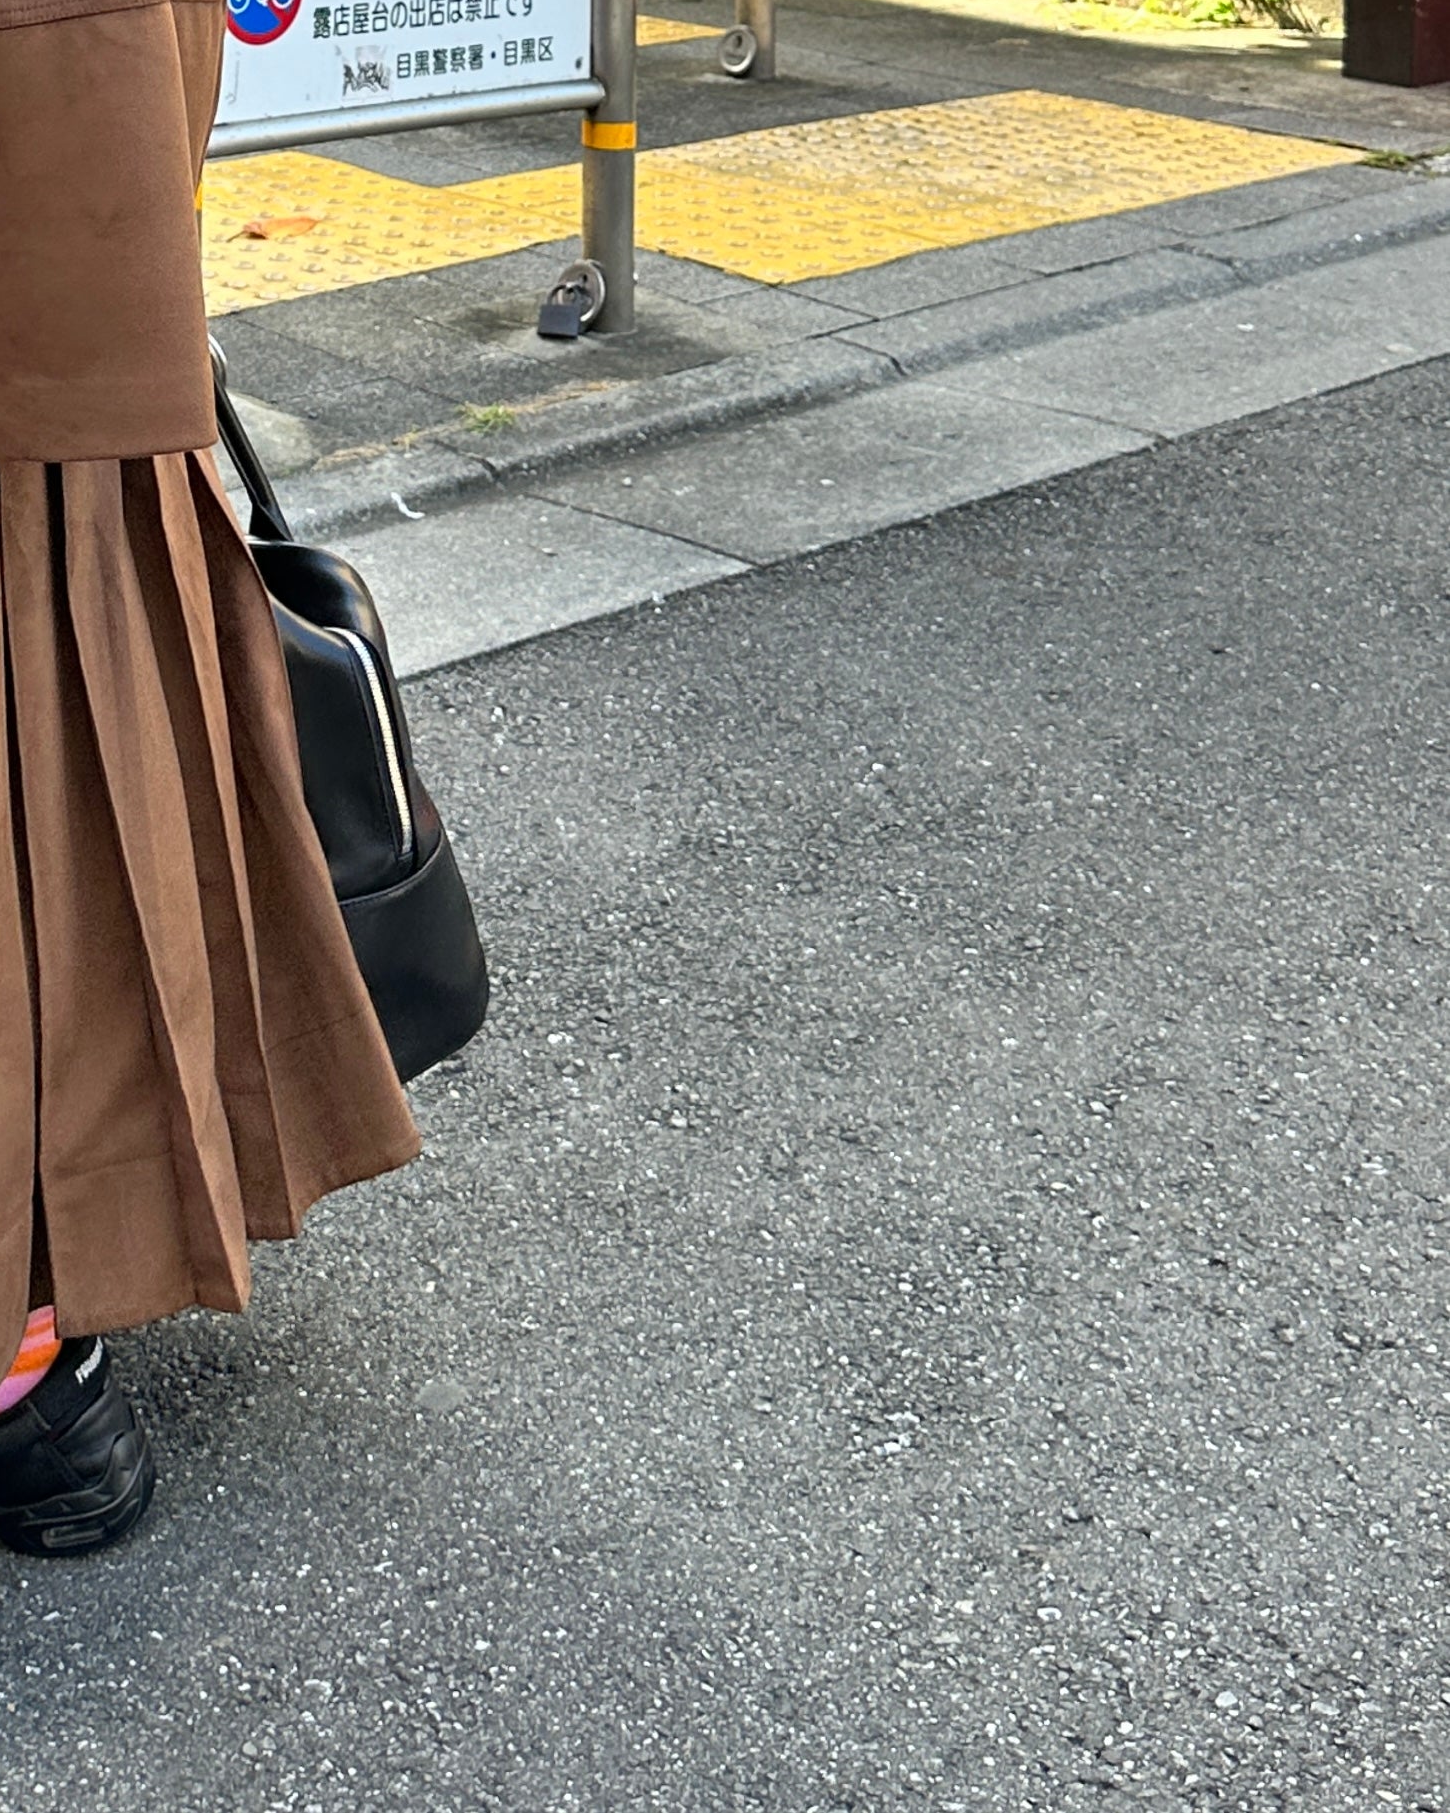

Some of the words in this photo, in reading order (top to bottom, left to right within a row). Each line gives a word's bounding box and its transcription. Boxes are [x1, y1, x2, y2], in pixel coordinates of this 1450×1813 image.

[397, 36, 554, 79] 目黒警察署・目黒区
